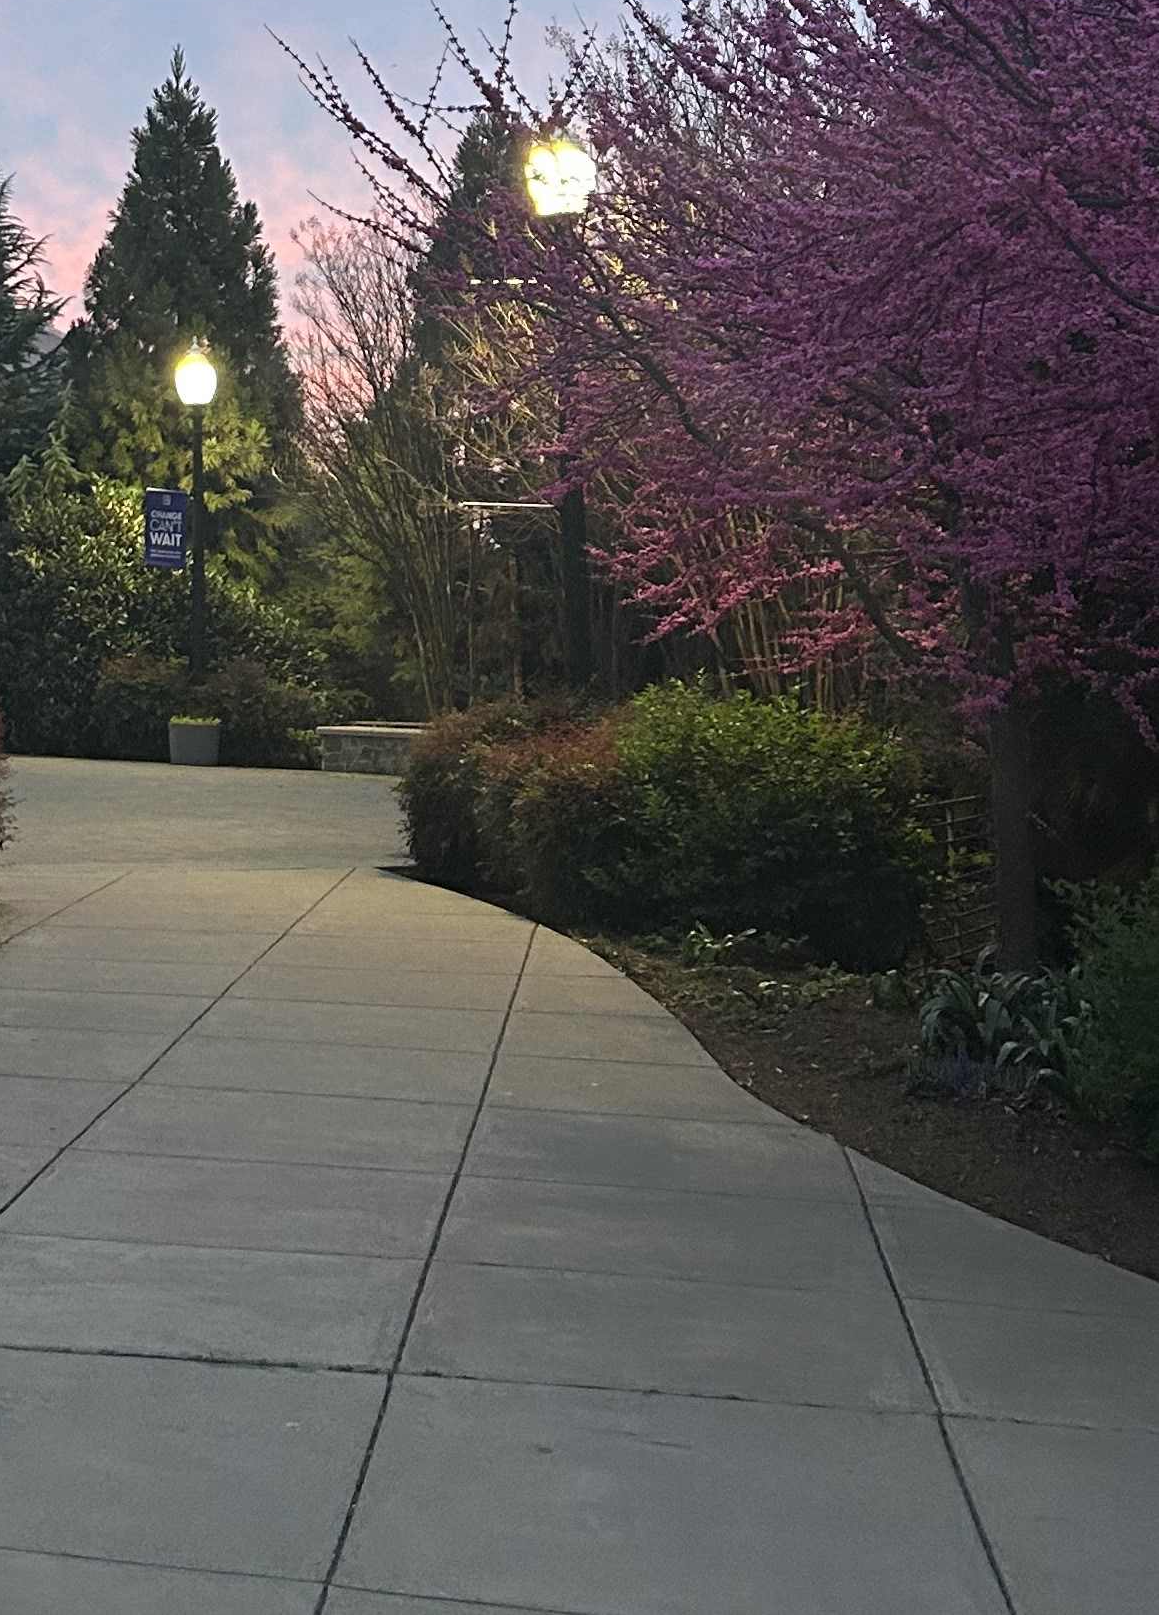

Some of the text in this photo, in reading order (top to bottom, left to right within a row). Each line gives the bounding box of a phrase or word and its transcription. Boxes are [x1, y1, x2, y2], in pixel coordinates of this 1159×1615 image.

[150, 510, 182, 520] CHANGE
[150, 519, 182, 532] CAN'T
[150, 531, 182, 546] WAIT
